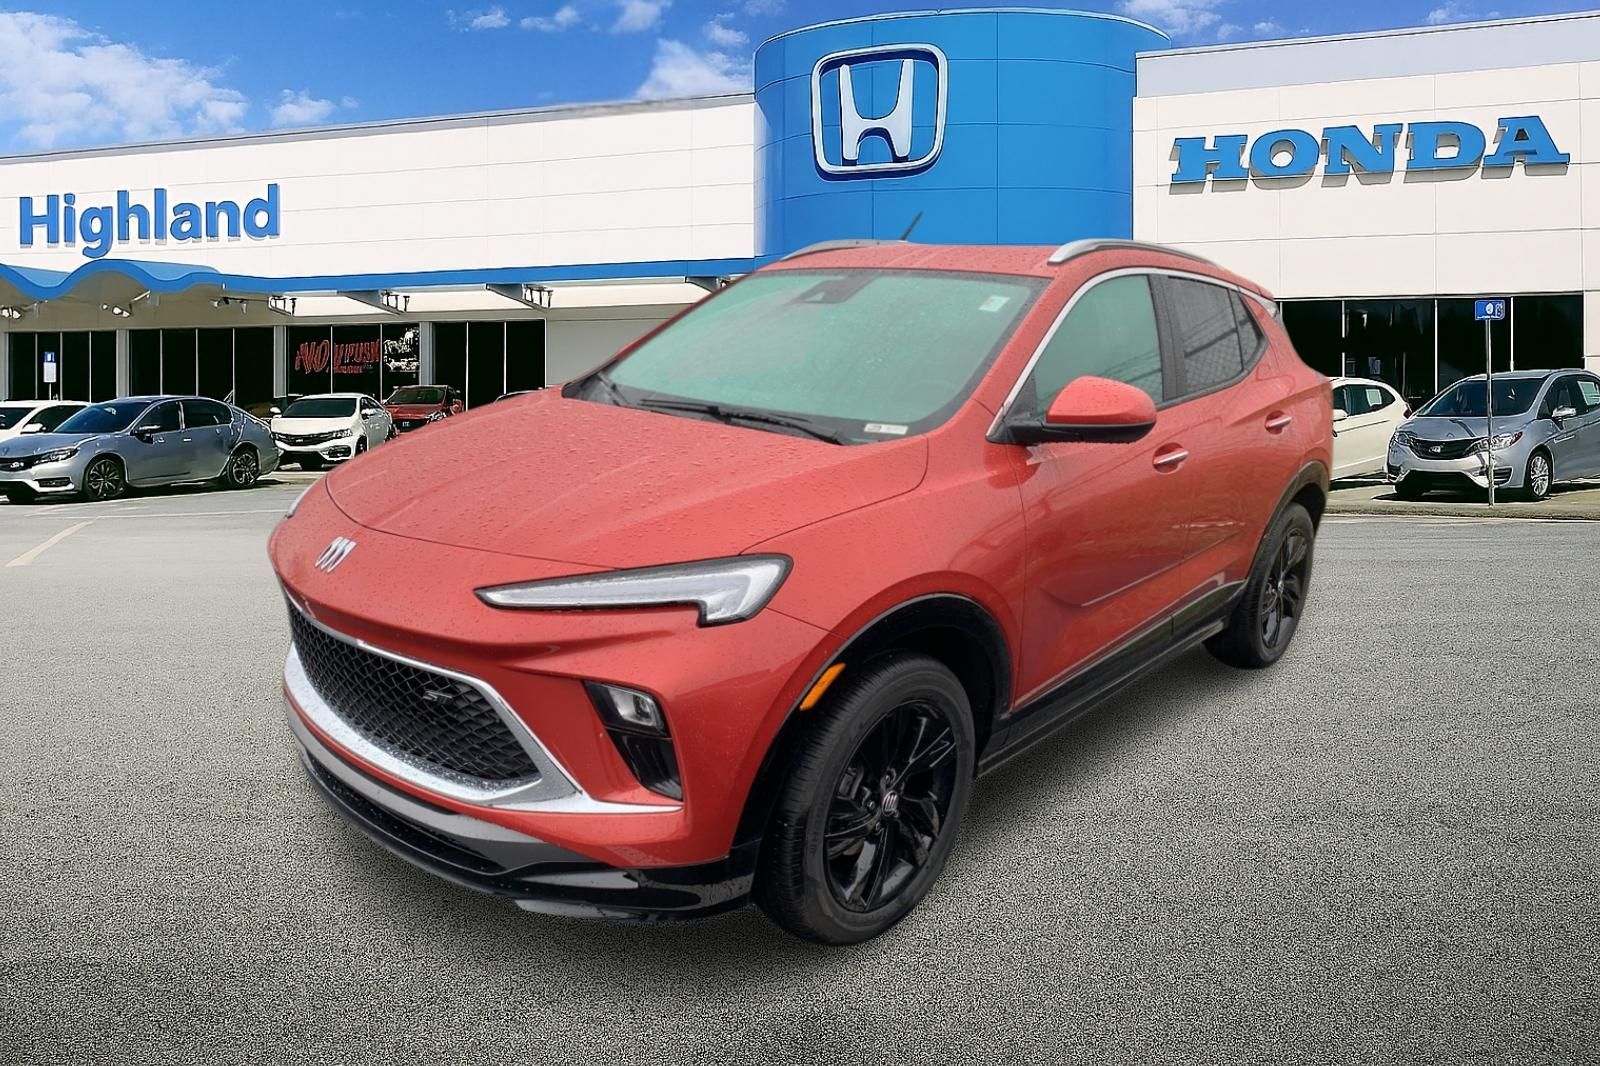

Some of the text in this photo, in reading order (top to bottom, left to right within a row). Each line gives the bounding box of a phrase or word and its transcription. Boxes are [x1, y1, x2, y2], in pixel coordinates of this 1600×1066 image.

[839, 58, 914, 160] H
[1171, 115, 1570, 185] HONDA
[19, 183, 280, 258] Highland
